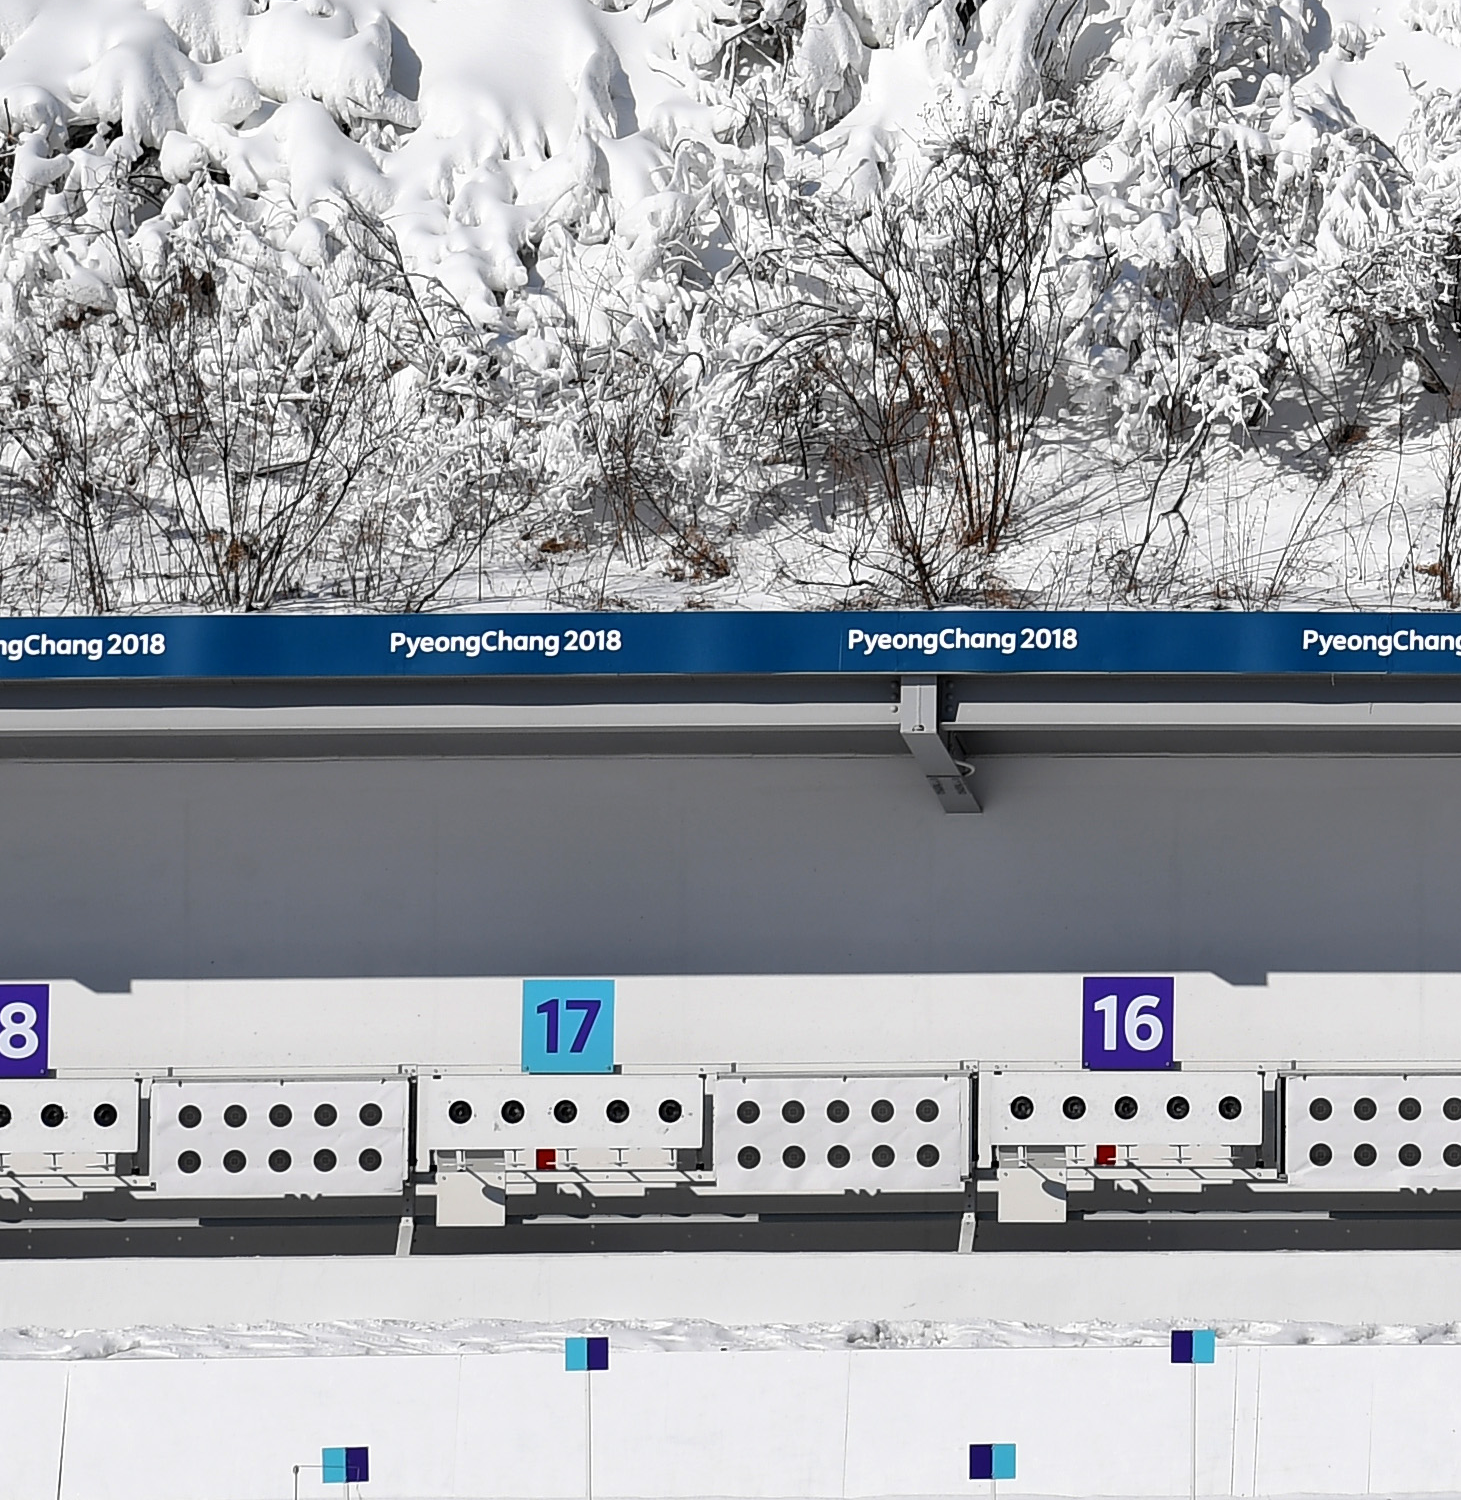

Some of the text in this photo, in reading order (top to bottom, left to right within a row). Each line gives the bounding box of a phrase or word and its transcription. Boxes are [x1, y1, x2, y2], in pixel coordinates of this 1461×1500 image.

[107, 634, 165, 654] 2018
[391, 630, 621, 658] PyeongChang 2018
[849, 628, 1077, 655] PyeongChang 2018
[0, 1001, 39, 1059] 8
[537, 999, 601, 1053] 17
[1093, 994, 1164, 1052] 16
